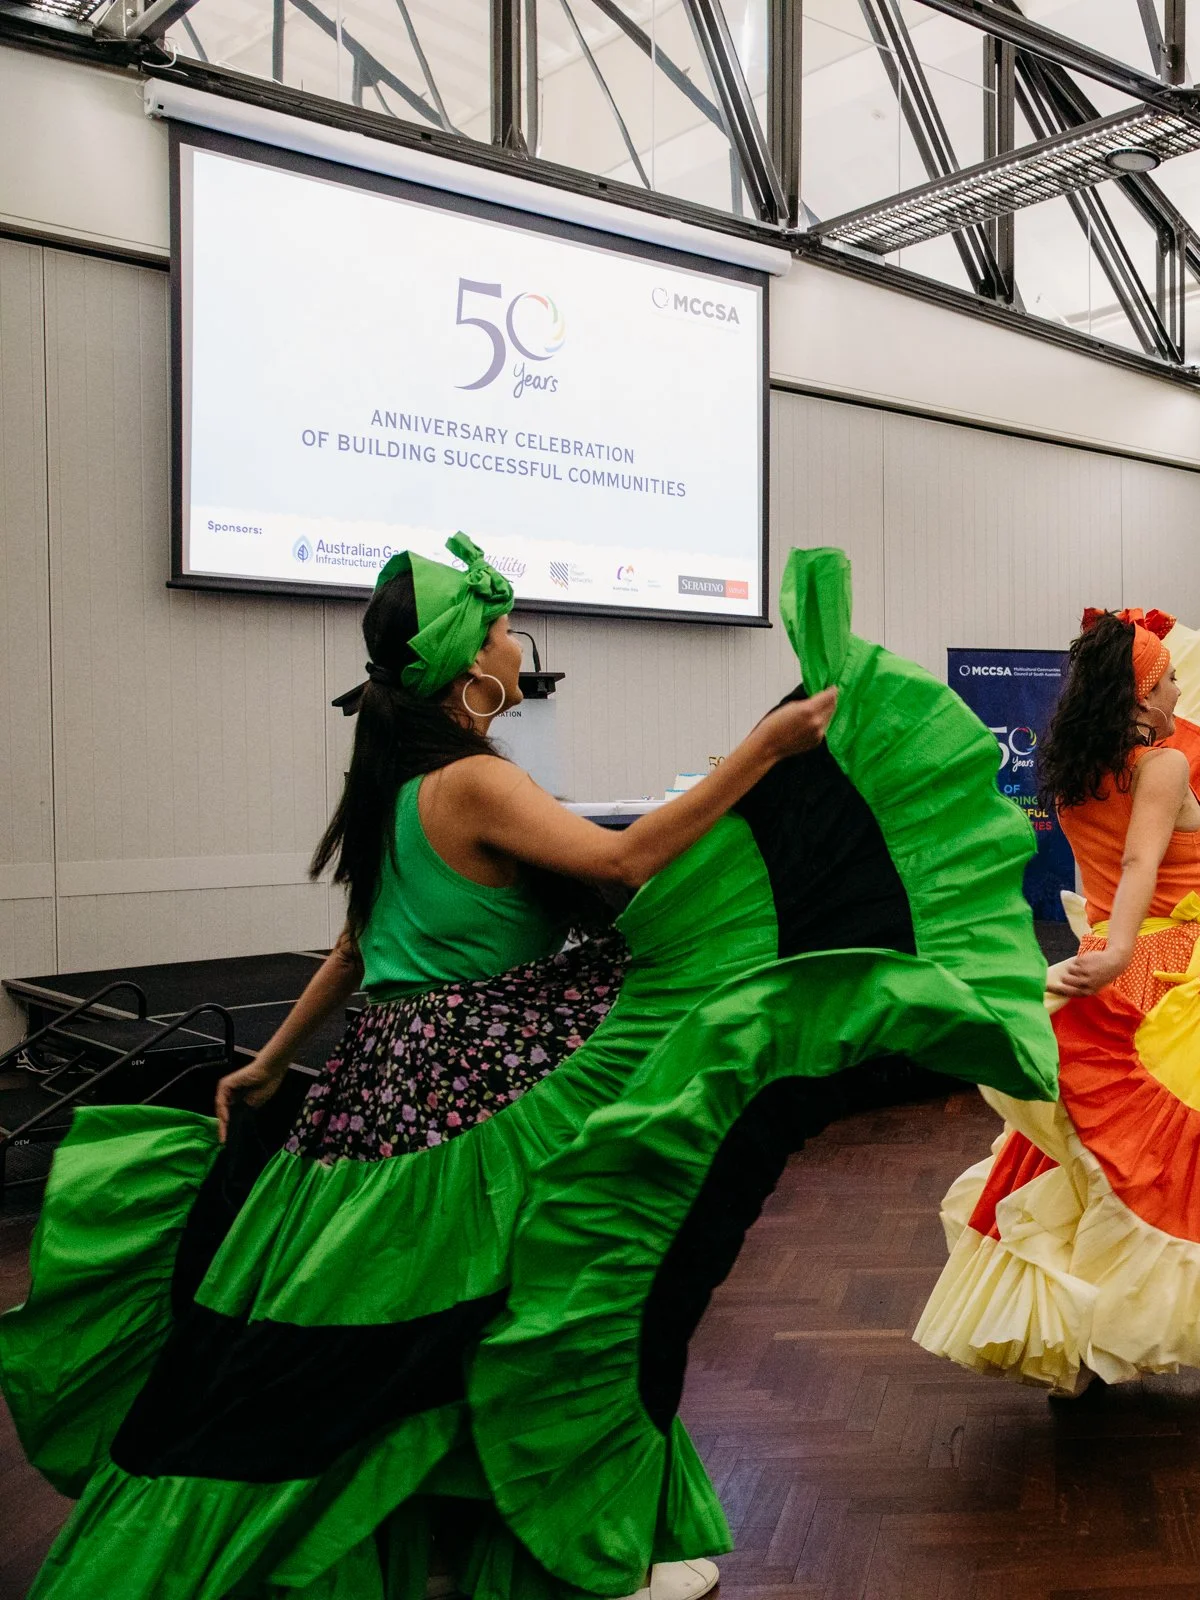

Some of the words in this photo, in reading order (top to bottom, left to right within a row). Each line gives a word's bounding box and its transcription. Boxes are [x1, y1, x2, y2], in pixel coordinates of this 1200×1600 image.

[673, 293, 740, 325] MCCSA
[454, 277, 566, 391] 50
[371, 409, 508, 445] ANNIVERSARY
[515, 432, 635, 464] CELEBRATION
[302, 429, 329, 448] OF
[338, 434, 436, 463] BUILDING
[444, 449, 562, 481] SUCCESSFUL
[568, 467, 686, 497] COMMUNITIES
[207, 520, 263, 535] Sponsors:
[316, 539, 380, 558] Australian
[316, 554, 377, 569] Infrastructure
[681, 578, 724, 593] SERAFINO
[972, 666, 1012, 676] MCCSA
[1003, 784, 1020, 794] OF
[1012, 796, 1038, 805] DING
